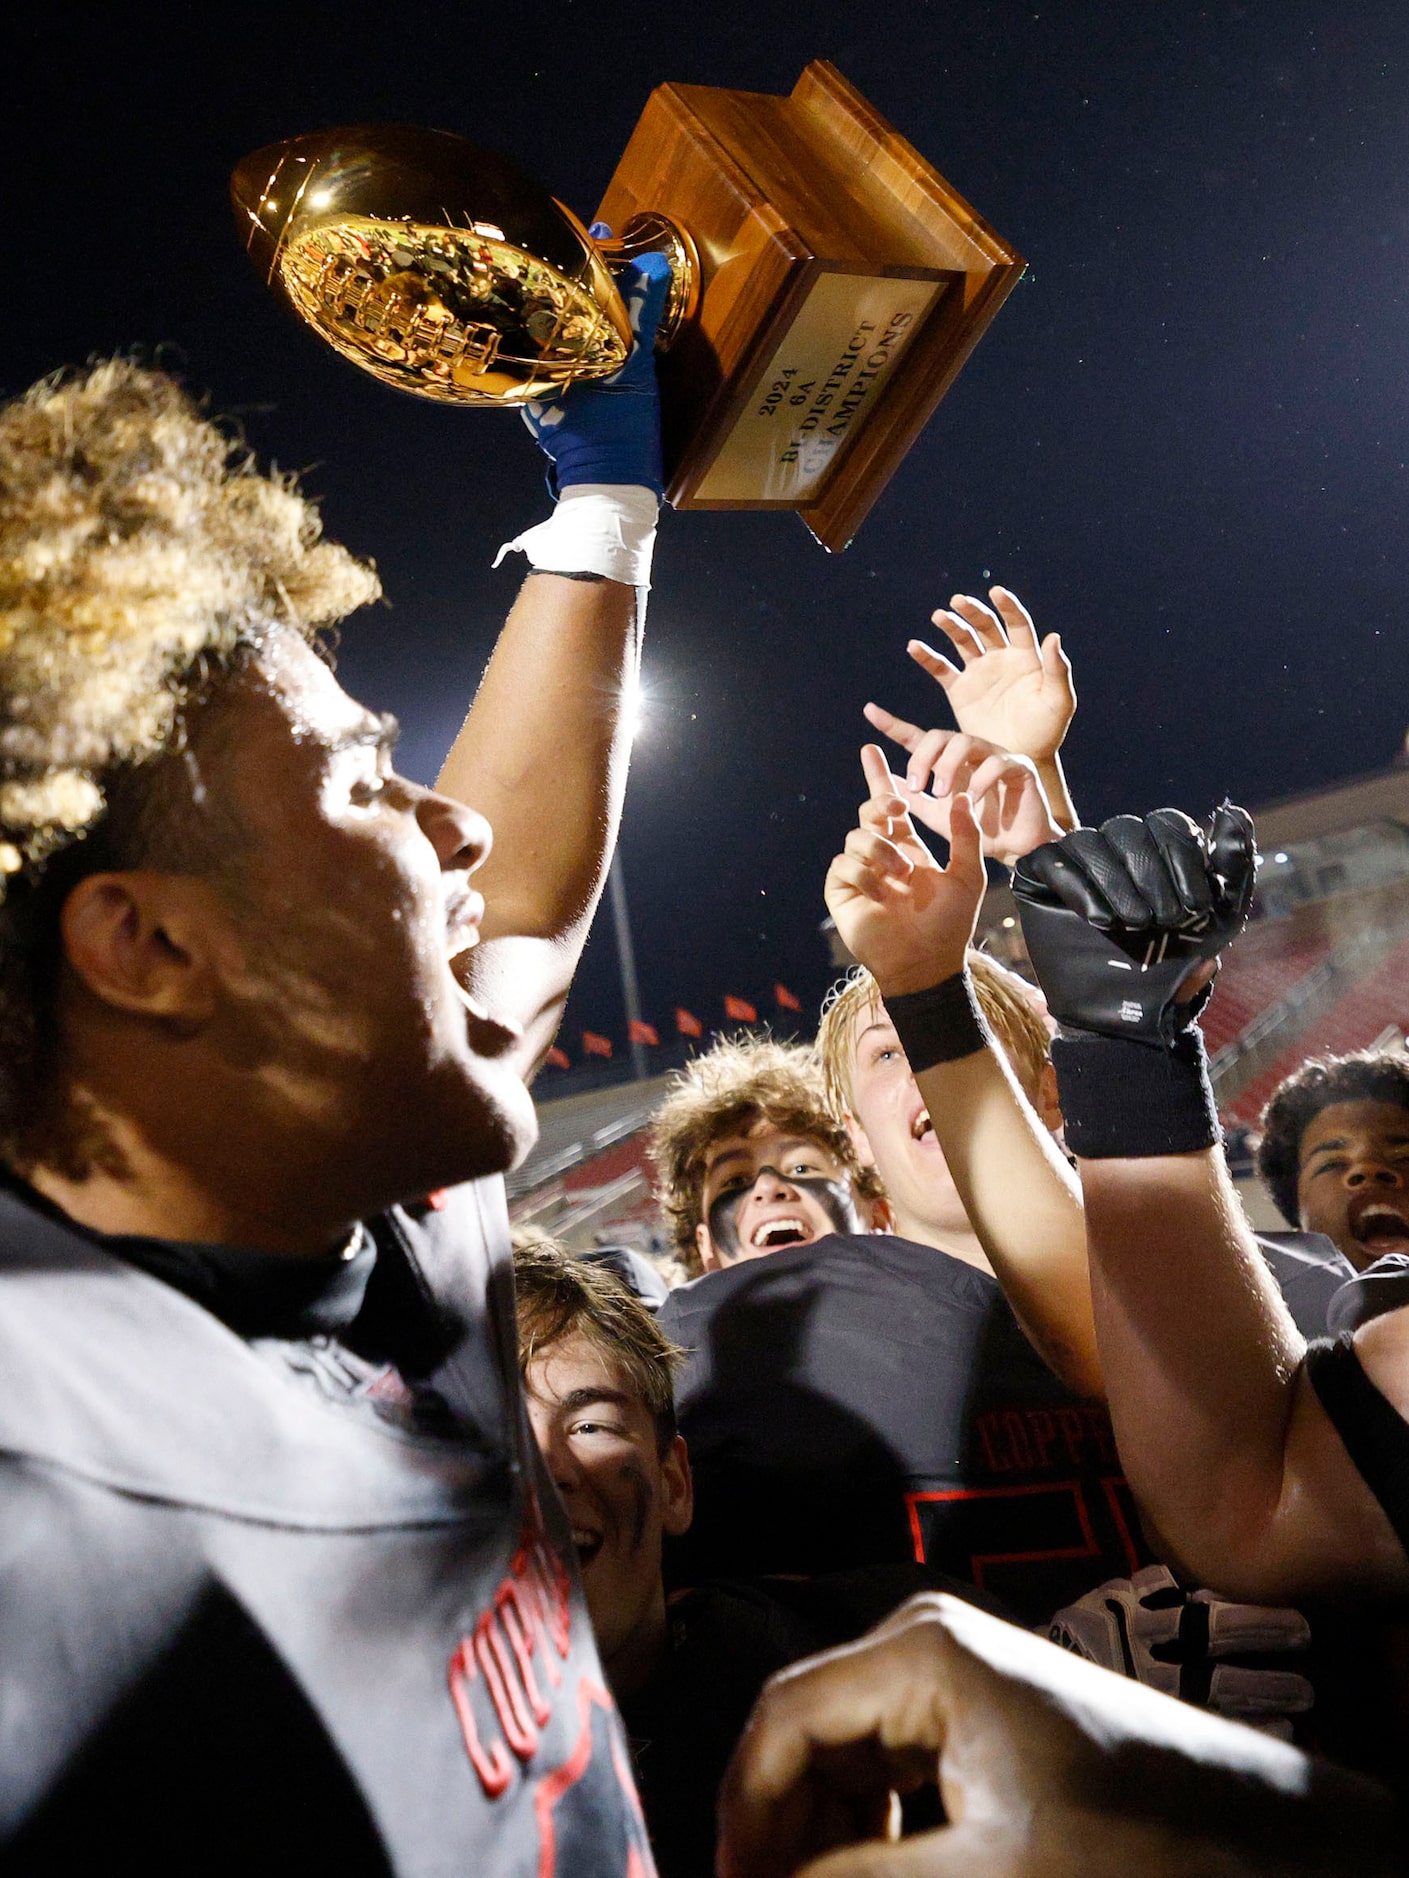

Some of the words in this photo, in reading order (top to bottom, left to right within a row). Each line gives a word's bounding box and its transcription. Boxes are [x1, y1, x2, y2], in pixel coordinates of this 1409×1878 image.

[759, 367, 798, 416] 2024
[789, 380, 816, 406] 6A
[803, 312, 913, 474] CHAMPIONS
